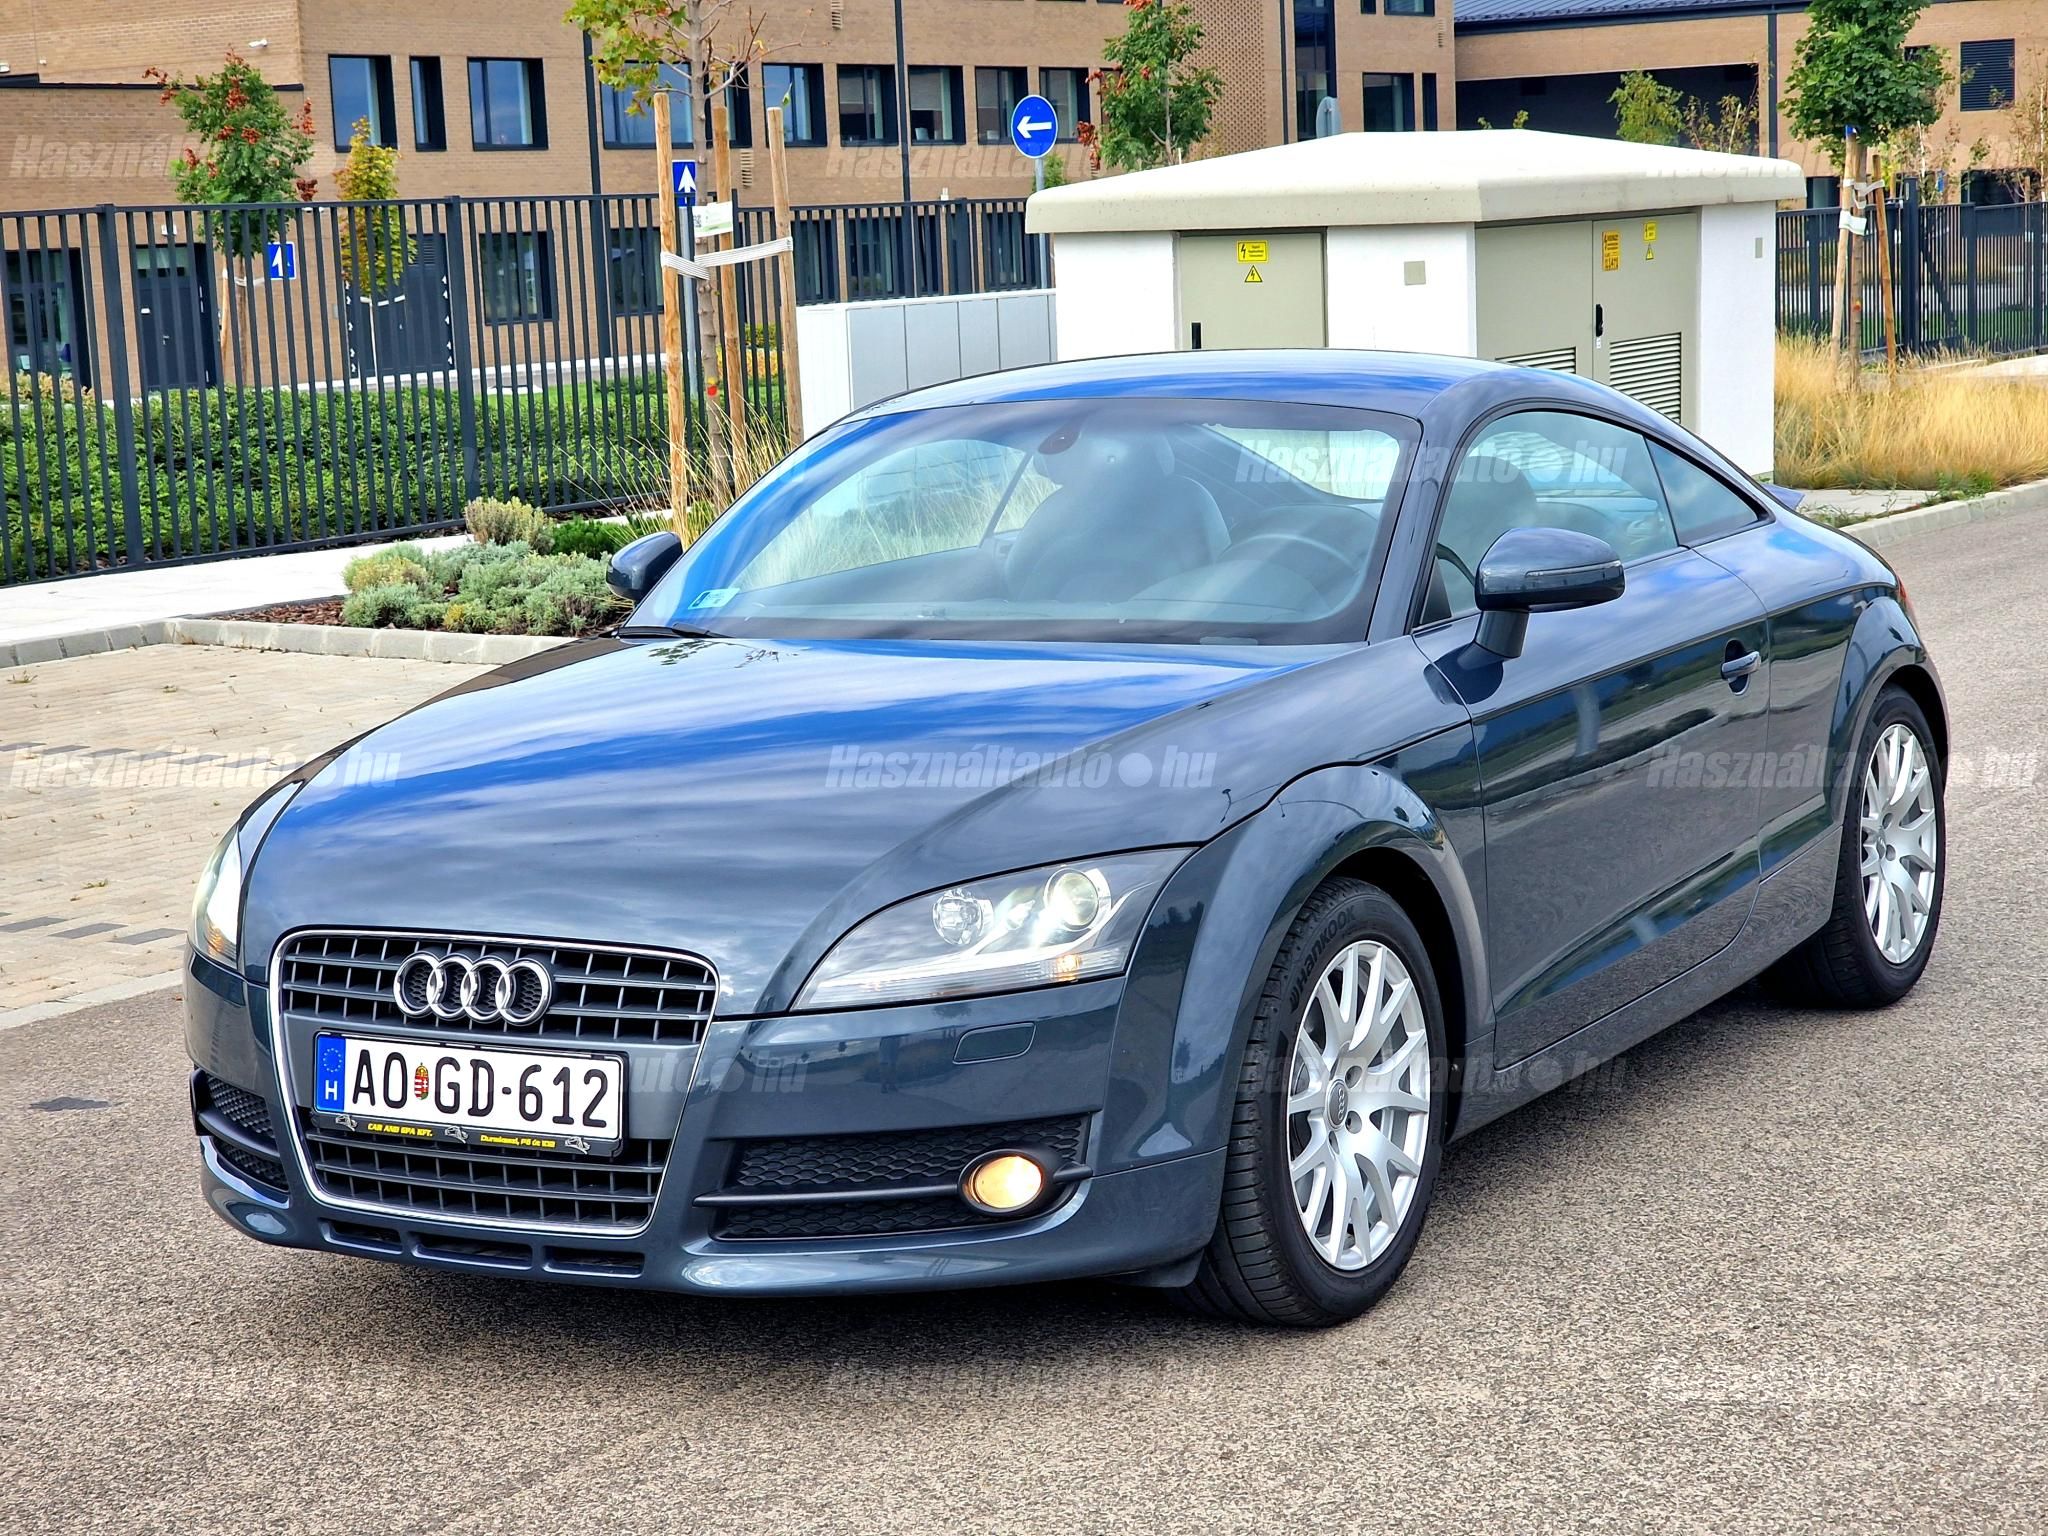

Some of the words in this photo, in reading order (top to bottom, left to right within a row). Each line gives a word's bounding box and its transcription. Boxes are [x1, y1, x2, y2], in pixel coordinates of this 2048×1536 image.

[324, 1079, 339, 1101] H
[352, 1049, 408, 1109] AO
[434, 1057, 608, 1129] GD-612
